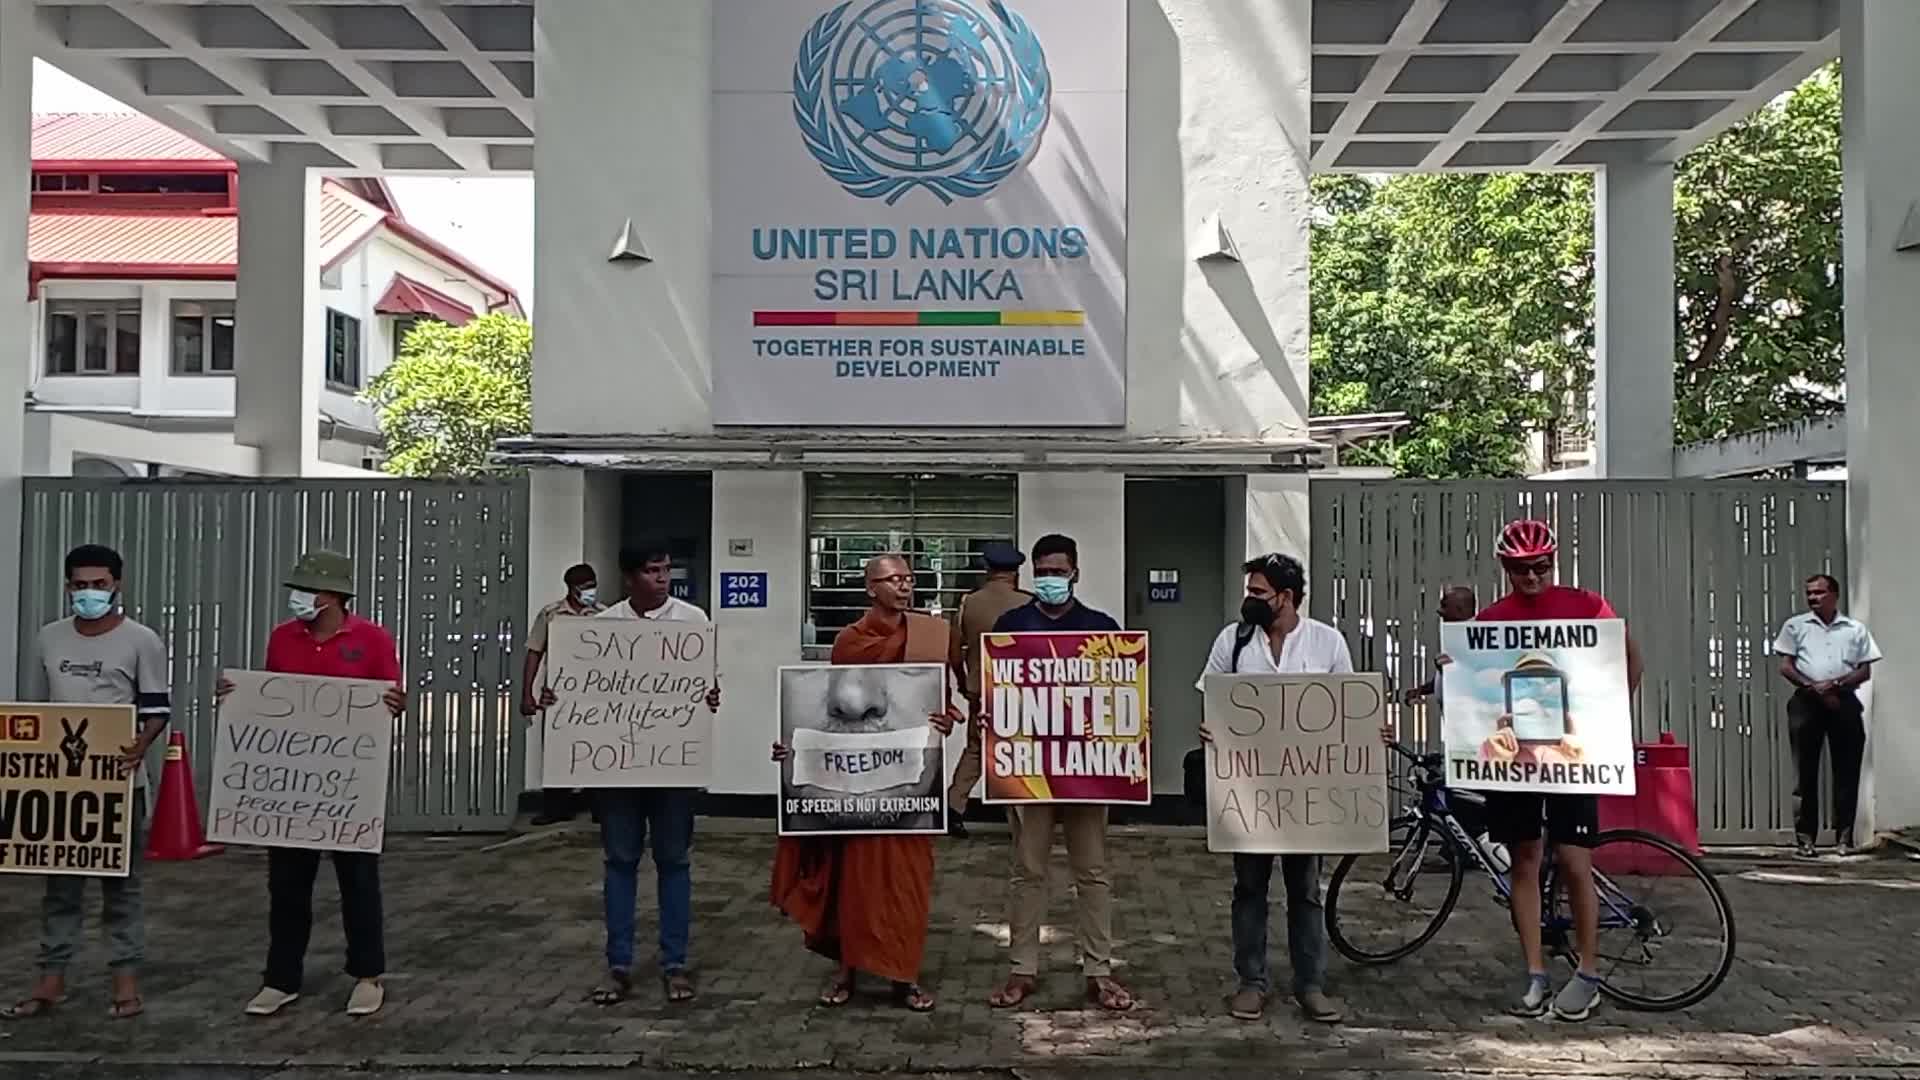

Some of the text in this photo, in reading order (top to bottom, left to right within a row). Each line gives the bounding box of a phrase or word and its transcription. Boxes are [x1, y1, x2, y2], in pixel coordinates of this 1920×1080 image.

[752, 227, 1088, 260] UNITED NATIONS
[814, 268, 1024, 301] SRI LANKA
[752, 339, 1085, 356] TOGETHER FOR SUSTAINABLE
[836, 360, 1000, 377] DEVELOPMENT
[673, 585, 689, 597] IN
[728, 576, 760, 589] 202
[1151, 588, 1177, 600] OUT
[728, 592, 760, 605] 204
[573, 629, 642, 661] SAY
[1466, 625, 1598, 650] WE DEMAND
[552, 667, 577, 692] to
[992, 658, 1137, 684] WE STAND FOR
[256, 676, 380, 725] STOP
[992, 686, 1140, 738] UNITED
[1229, 680, 1379, 743] STOP
[552, 700, 696, 730] the Military
[0, 752, 59, 778] ISTEN
[570, 740, 701, 775] POLICE
[824, 749, 904, 774] FREEDOM
[994, 741, 1142, 777] SRI LANKA
[1213, 743, 1384, 780] UNLAWFUL
[223, 762, 359, 801] against
[1452, 759, 1625, 784] TRANSPARENCY
[786, 797, 940, 814] OF SPEECH IS NOT EXTREMISM
[1217, 785, 1385, 833] ARRESTS
[0, 843, 122, 869] F THE PEOPLE
